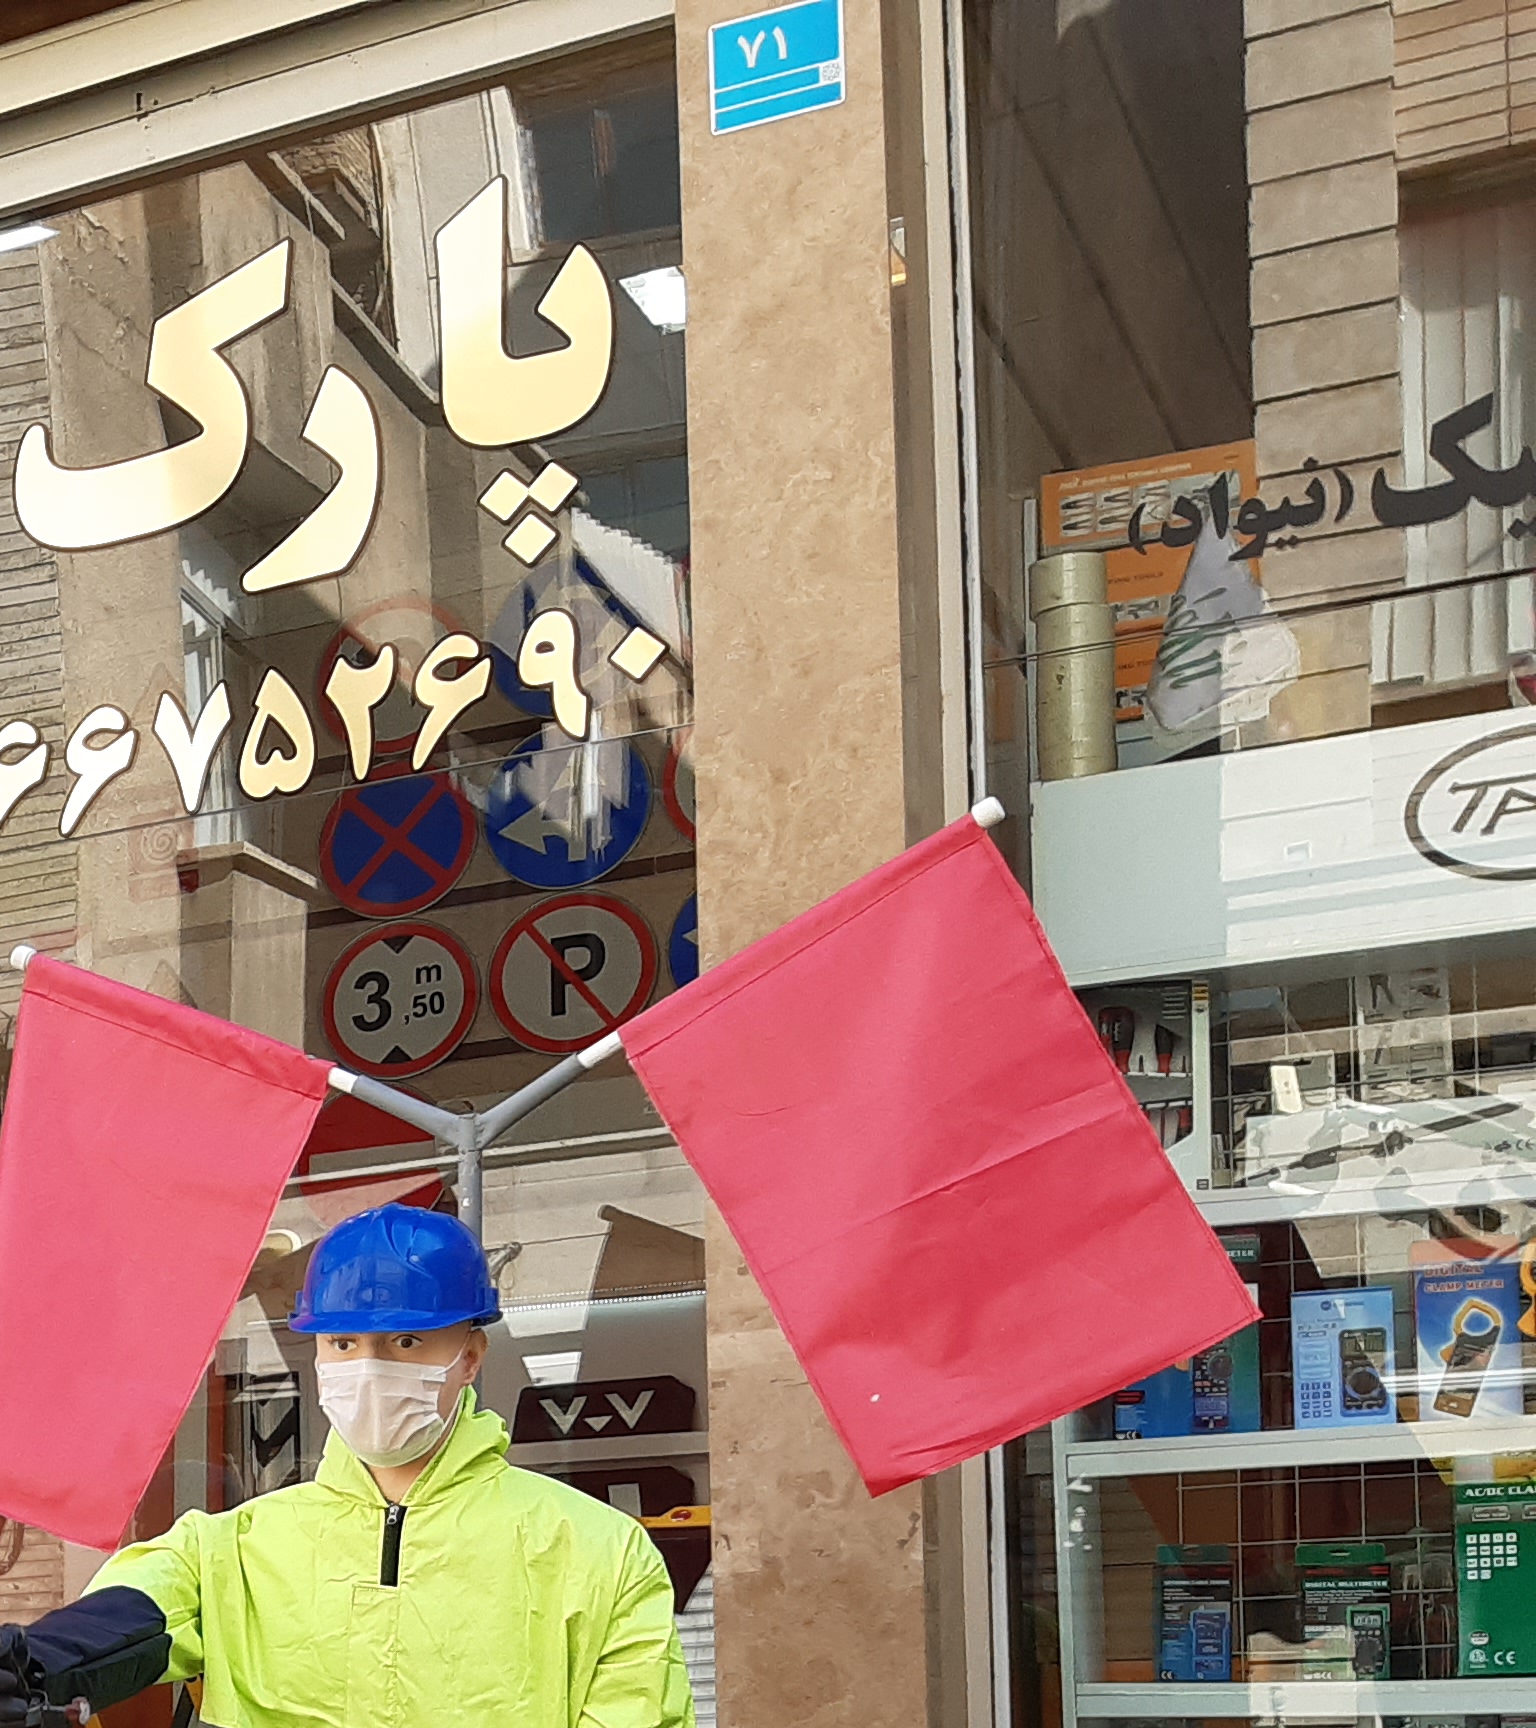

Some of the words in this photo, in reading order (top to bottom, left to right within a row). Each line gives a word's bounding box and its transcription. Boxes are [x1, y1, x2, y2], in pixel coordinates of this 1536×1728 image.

[737, 26, 788, 68] ۷۱
[14, 173, 616, 592] پارک
[551, 933, 605, 1017] P
